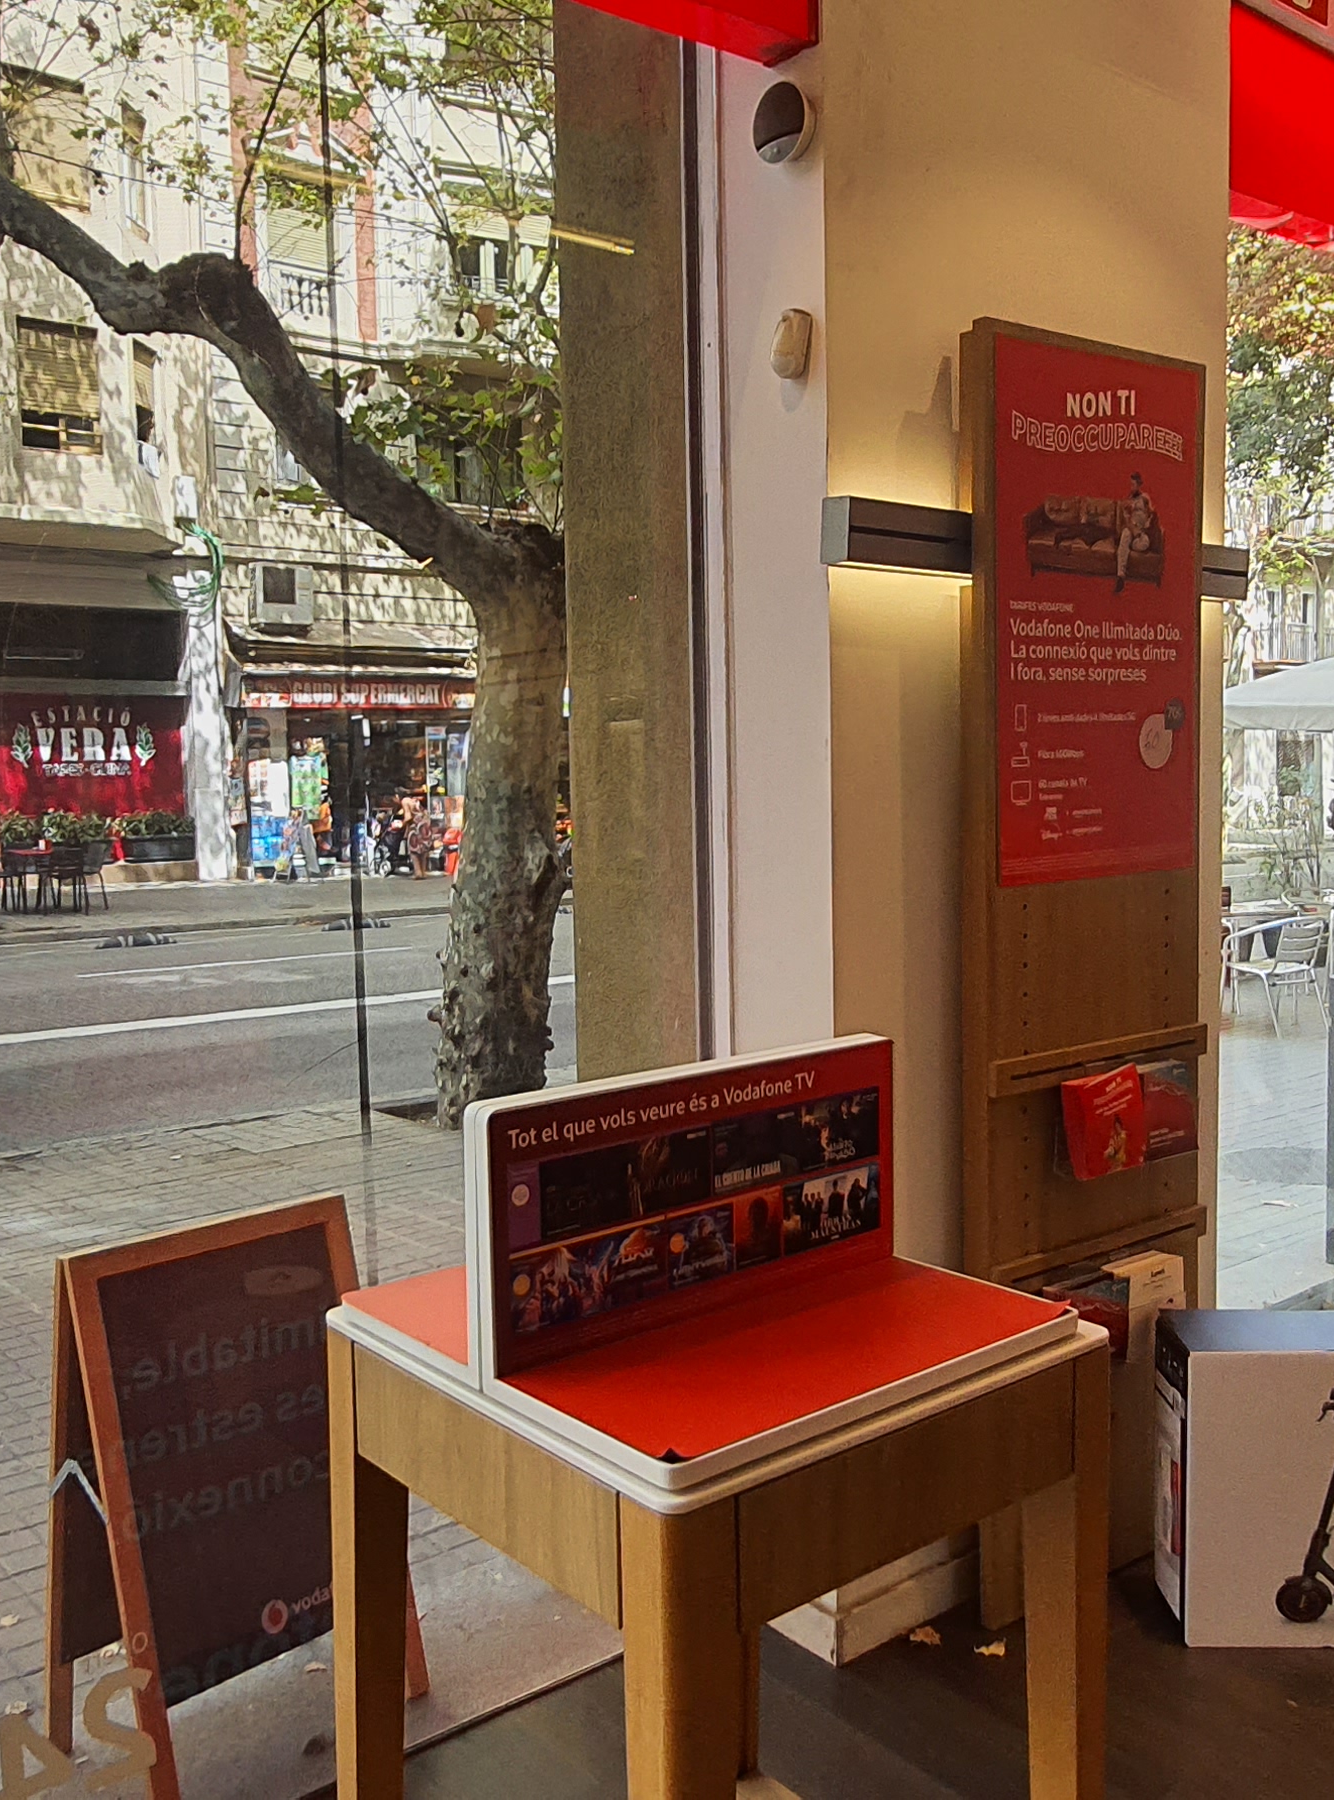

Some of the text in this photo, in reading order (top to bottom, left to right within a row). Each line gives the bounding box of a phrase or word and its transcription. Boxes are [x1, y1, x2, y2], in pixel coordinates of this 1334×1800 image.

[1067, 389, 1136, 418] NON TI
[1010, 617, 1072, 638] Vodafone
[1074, 620, 1100, 638] One
[1157, 623, 1183, 641] Dúo.
[1010, 640, 1177, 664] La connexió que vols dintre
[1016, 663, 1046, 682] fora,
[1049, 667, 1086, 682] sense
[1087, 668, 1147, 685] sorpreses
[340, 681, 443, 705] SUPERMERCAT
[30, 704, 132, 727] ESTACIÓ
[36, 727, 132, 763] VERA
[507, 1070, 815, 1149] Tot el que vols veure és a Vodafone TV
